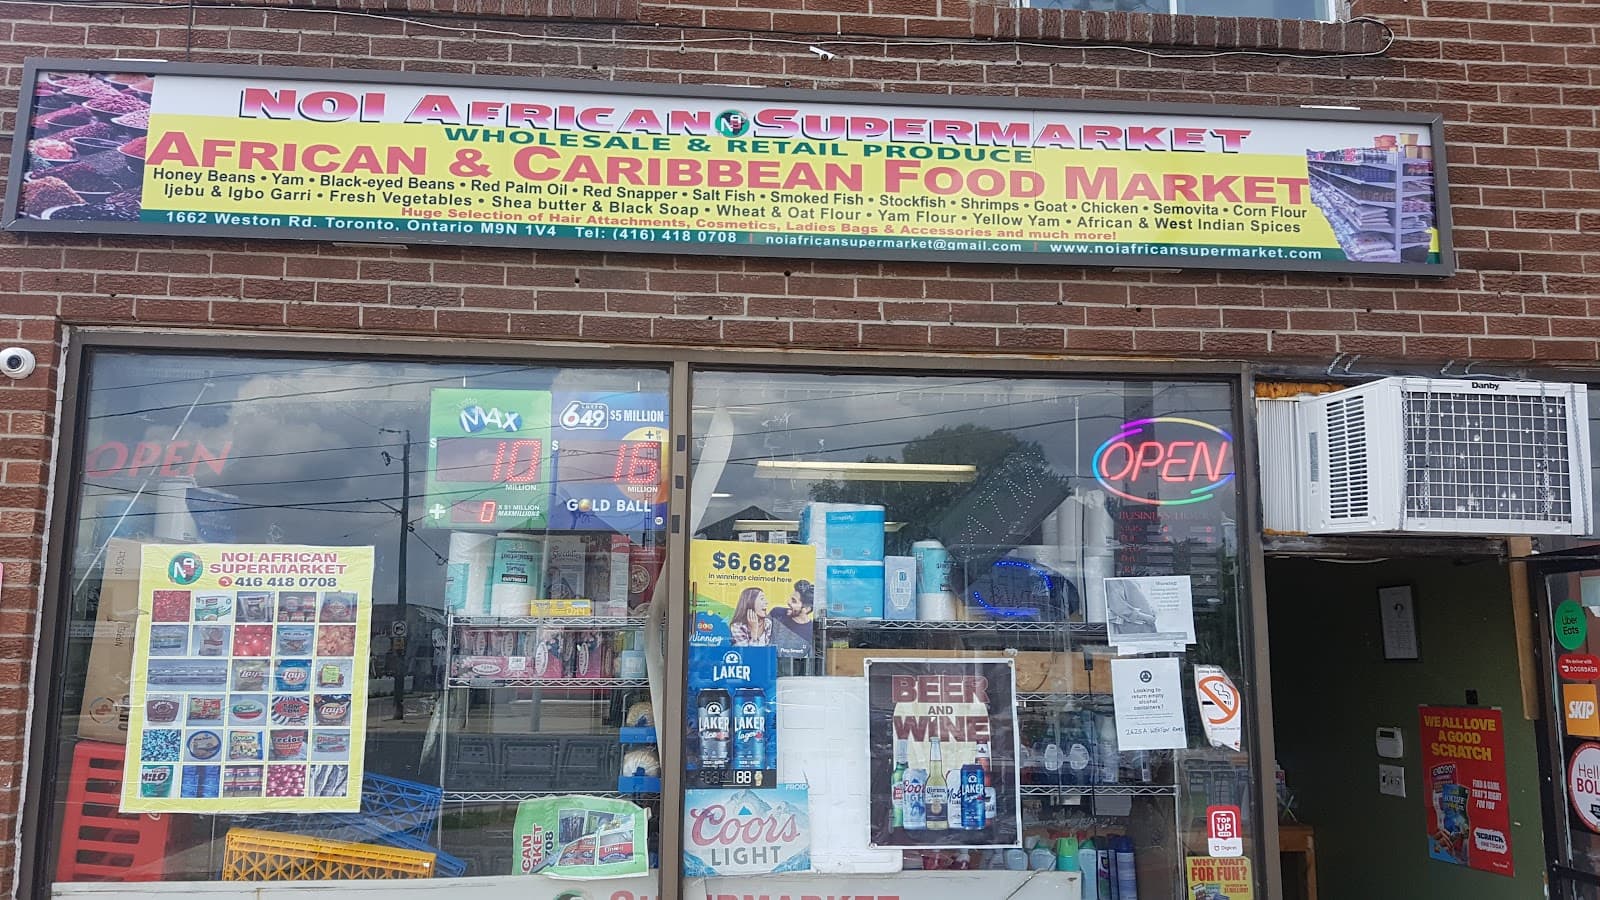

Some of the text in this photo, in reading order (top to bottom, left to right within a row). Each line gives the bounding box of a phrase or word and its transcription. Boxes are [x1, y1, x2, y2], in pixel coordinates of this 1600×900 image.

[239, 88, 1251, 153] NOI AFRICAN SUPERMARKET
[445, 128, 1032, 162] WHOLESALE & RETAIL PRODUCE
[146, 131, 1309, 205] AFRICAN & CARIBBEAN FOOD MARKET
[154, 168, 1307, 218] Honey Beans Yam Black-eyed Beans Red Palm Oil Red Snapper Salt Fish Smoked Fish Stockfish Shrimps Goat Chicken Semovita Corn Flour
[165, 184, 1300, 234] Ijebu & Igbo Garri Fresh Vegetables Shea butter & Black Soap Wheat & Oat Flour Yam Flour Yellow Yam African & West Indian Spices
[402, 207, 1116, 240] Huge Selection of Hair Attachments, Cosmetics, Ladies Bags & Accessories and much more!
[167, 212, 207, 223] 1662
[215, 213, 280, 226] Weston
[289, 216, 316, 227] Rd.
[407, 220, 473, 233] Ontario
[481, 223, 517, 234] M9N
[525, 225, 556, 236] 1V4
[575, 226, 605, 238] Tel:
[613, 227, 655, 241] (416)
[663, 230, 690, 240] 418
[698, 232, 736, 242] 0708
[766, 233, 1021, 251] noiafricansupermarket@gmail.com
[1050, 243, 1321, 259] www.noiafricansupermarket.com
[1472, 382, 1500, 391] Danby
[459, 406, 519, 433] MAX
[610, 410, 664, 423] $5 MILLION
[86, 440, 233, 478] OPEN
[492, 440, 541, 483] 10
[614, 442, 658, 484] 16
[1101, 441, 1228, 482] OPEN
[627, 486, 658, 494] MILLION
[616, 500, 652, 513] BALL
[221, 552, 338, 564] NOI AFRICAN
[713, 550, 790, 573] $6,682
[209, 563, 347, 575] SUPERMARKET
[234, 577, 338, 588] 416 418 0708
[715, 574, 747, 583] winnings
[748, 574, 776, 583] claimed
[1562, 616, 1578, 625] Uber
[1563, 626, 1580, 635] Eats
[713, 665, 751, 682] LAKER
[892, 674, 990, 703] BEER
[928, 705, 954, 716] AND
[1568, 701, 1595, 719] SKIP
[699, 716, 730, 733] LAKER
[734, 716, 765, 733] LAKER
[893, 715, 991, 743] WINE
[1424, 716, 1496, 731] WE ALL LOVE
[1438, 730, 1481, 745] A GOOD
[1431, 742, 1492, 761] SCRATCH
[961, 784, 986, 795] LAKER
[690, 804, 800, 847] Coors
[1217, 823, 1232, 831] UP
[1476, 831, 1505, 843] SCRATCH
[711, 846, 782, 867] LIGHT
[1192, 858, 1245, 866] WHY WAIT
[1191, 866, 1247, 881] FOR FUN?
